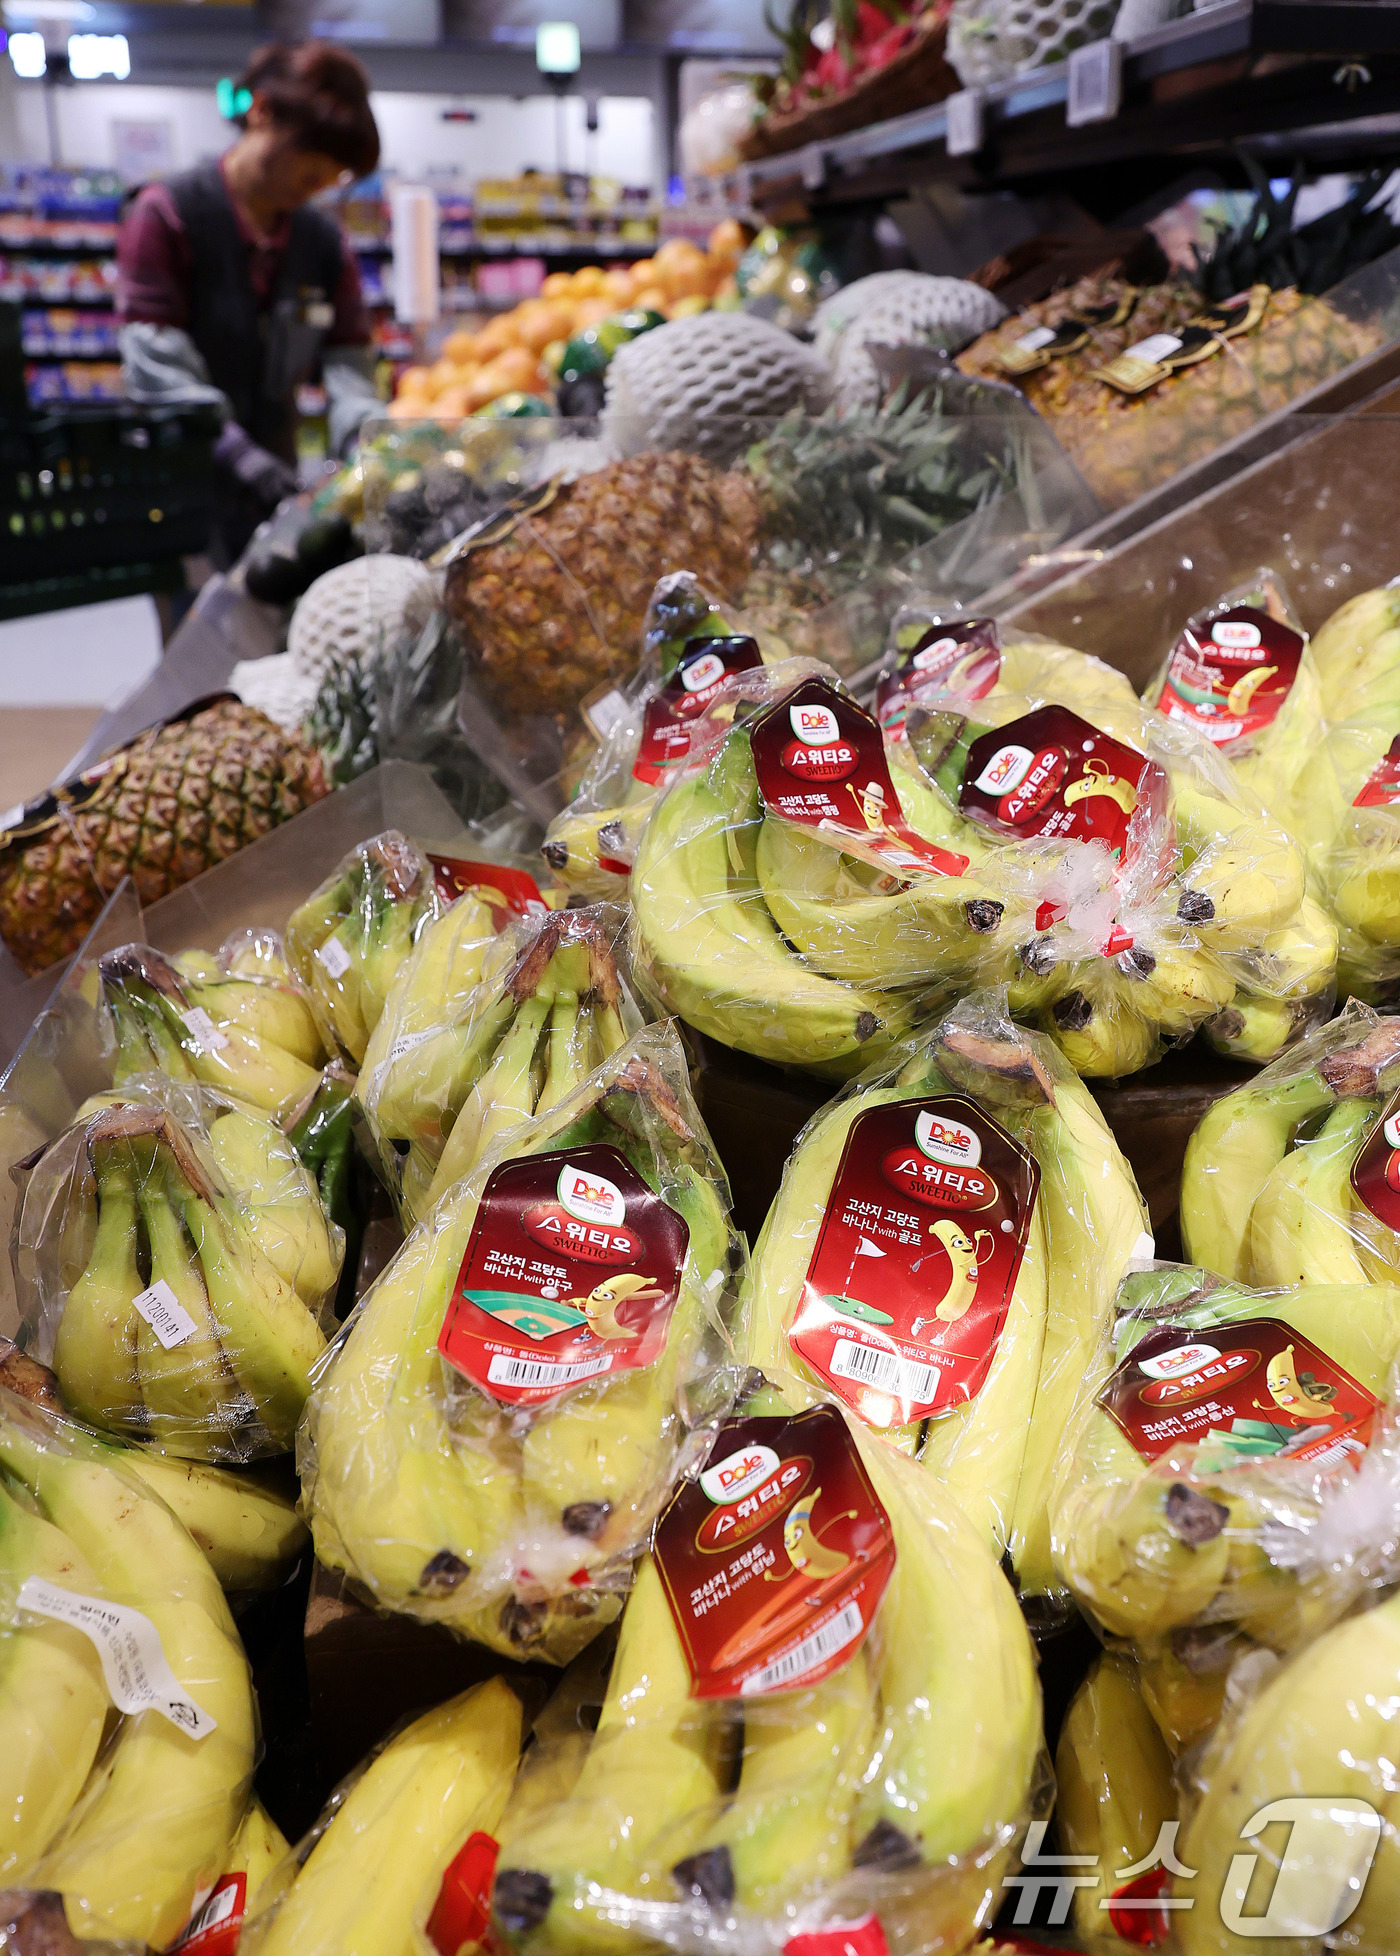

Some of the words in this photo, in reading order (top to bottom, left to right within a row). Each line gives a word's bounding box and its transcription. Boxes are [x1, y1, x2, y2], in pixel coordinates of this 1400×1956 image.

[801, 712, 829, 727] Dole
[791, 748, 853, 766] 스위티오
[805, 765, 842, 777] SWEETIO
[988, 753, 1016, 783] Dole
[777, 795, 805, 807] 고산지
[804, 793, 831, 805] 고당도
[1008, 752, 1059, 818] 스위티오
[783, 806, 810, 817] 바나나
[821, 804, 840, 816] 캠핑
[1040, 810, 1064, 837] 고당도
[1058, 811, 1077, 832] 골프
[926, 1141, 950, 1154] Sunshine
[929, 1121, 971, 1149] Dole
[572, 1178, 615, 1206] Dole
[893, 1159, 985, 1196] 스위티오
[908, 1180, 963, 1204] SWEETIO
[569, 1198, 593, 1213] Sunshine
[593, 1206, 603, 1214] For
[845, 1198, 882, 1219] 고산지
[883, 1209, 920, 1230] 고당도
[535, 1216, 631, 1254] 스위티오
[841, 1212, 879, 1234] 바나나
[878, 1227, 898, 1239] with
[898, 1228, 923, 1246] 골프
[553, 1236, 609, 1260] SWEETIO
[483, 1262, 524, 1280] 바나나
[524, 1273, 546, 1285] with
[545, 1277, 573, 1292] 야구
[486, 1249, 526, 1269] 고산지
[528, 1260, 567, 1279] 고당도
[141, 1292, 180, 1338] 11200141
[829, 1323, 858, 1339] 상품명:
[929, 1352, 956, 1369] 바나나
[1156, 1349, 1201, 1369] Dole
[1159, 1355, 1248, 1400] 스위티오
[1141, 1416, 1181, 1434] 고산지
[1182, 1401, 1221, 1422] 고당도
[1146, 1426, 1188, 1441] 바나나
[1187, 1417, 1211, 1430] with
[1208, 1405, 1236, 1422] 등산
[718, 1455, 762, 1488] Dole
[713, 1466, 801, 1540] 스위티오
[690, 1570, 727, 1606] 고산지
[729, 1542, 766, 1578] 고당도
[693, 1583, 731, 1618] 바나나
[731, 1570, 752, 1591] with
